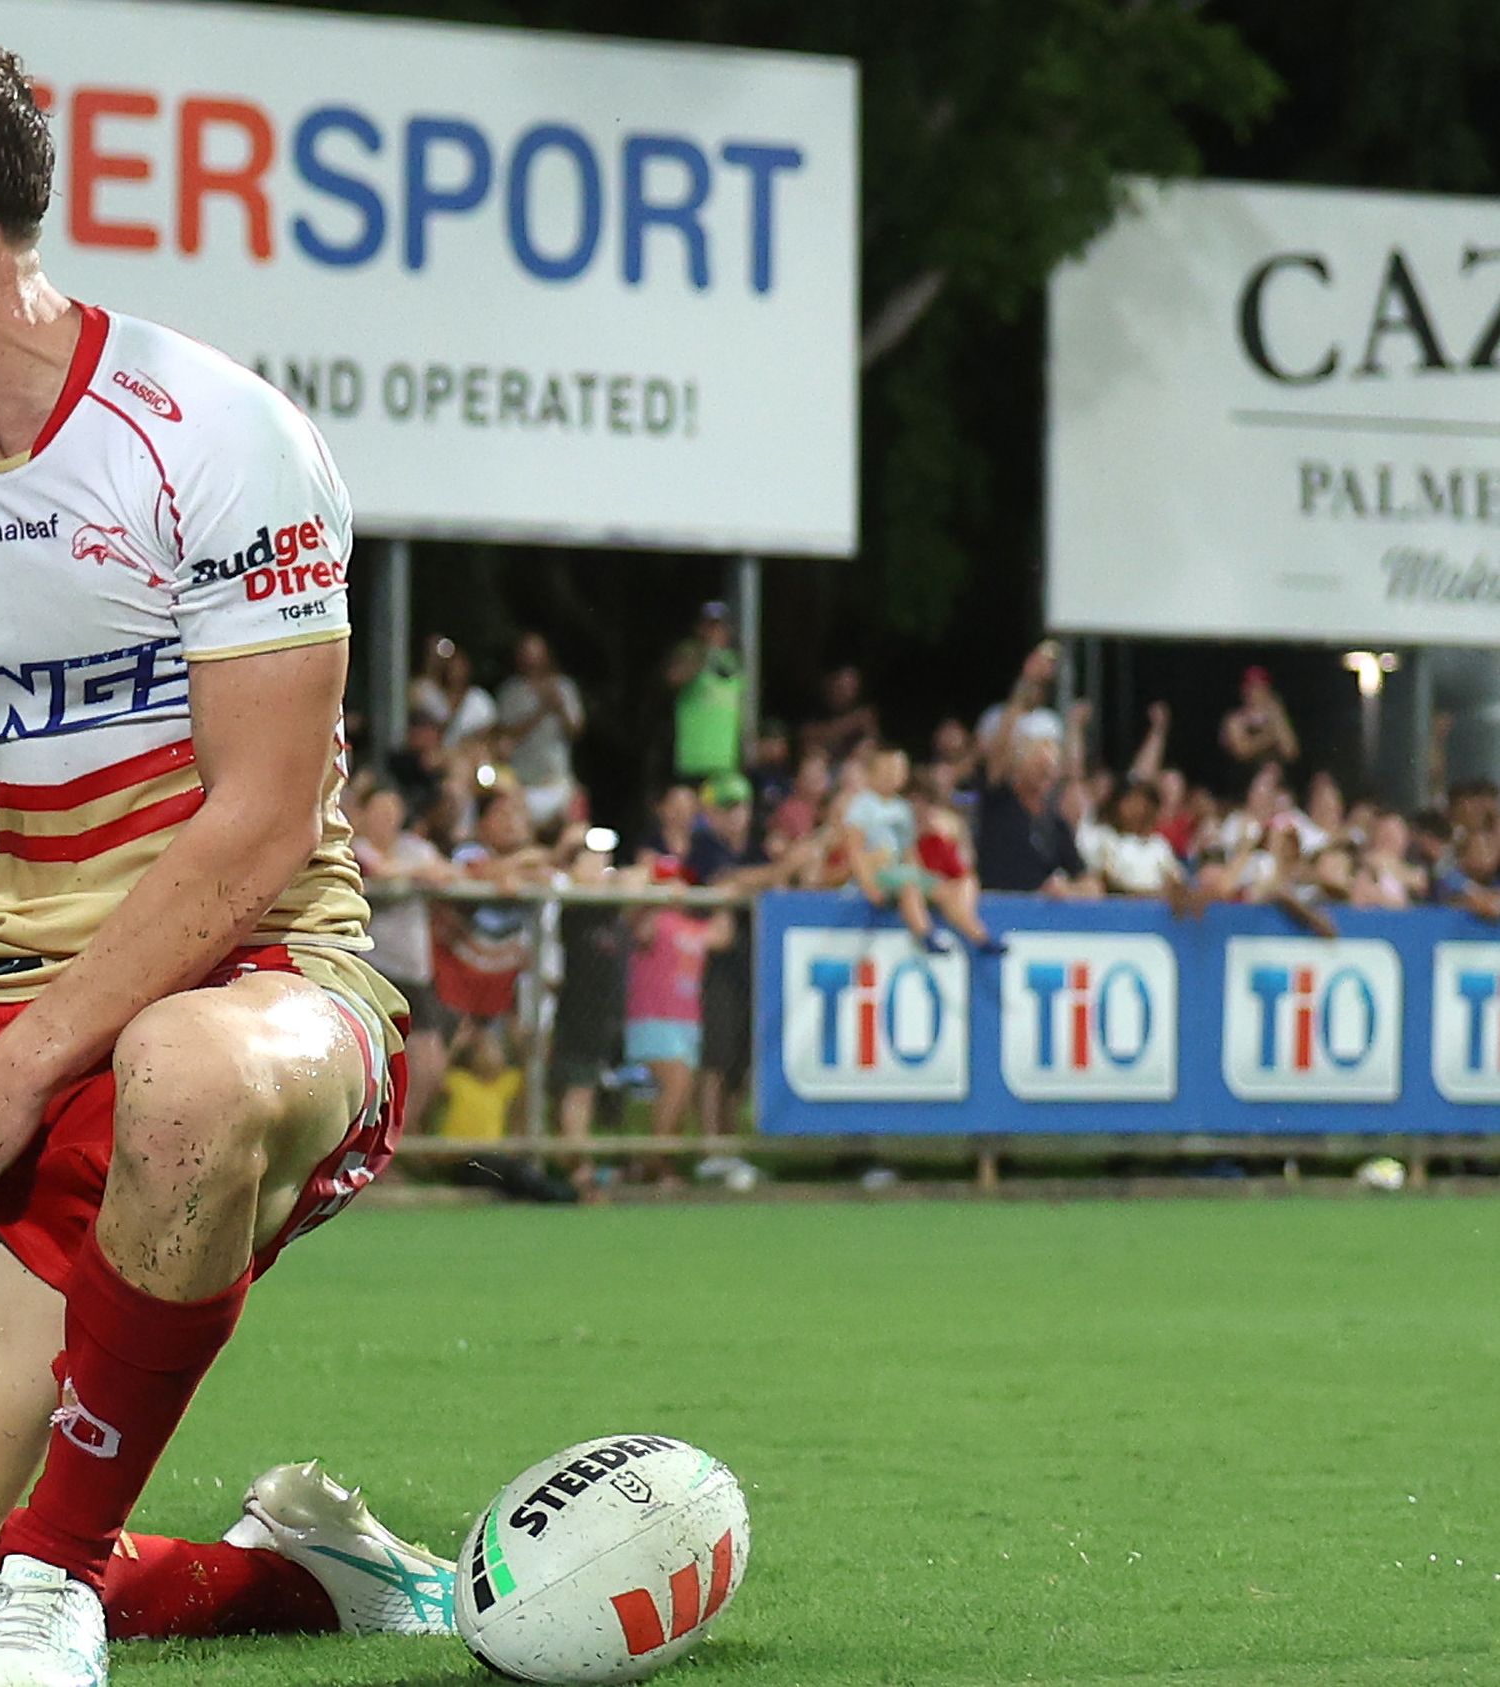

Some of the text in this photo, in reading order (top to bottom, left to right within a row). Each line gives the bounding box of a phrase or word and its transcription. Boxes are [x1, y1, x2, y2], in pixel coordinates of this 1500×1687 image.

[113, 370, 167, 411] CLASSIC
[254, 357, 362, 419] ND
[383, 360, 698, 438] OPERATED!
[810, 959, 942, 1070] TiO
[1025, 961, 1152, 1070] TiO
[1250, 965, 1377, 1071] TiO
[509, 1437, 677, 1538] STEEDEN
